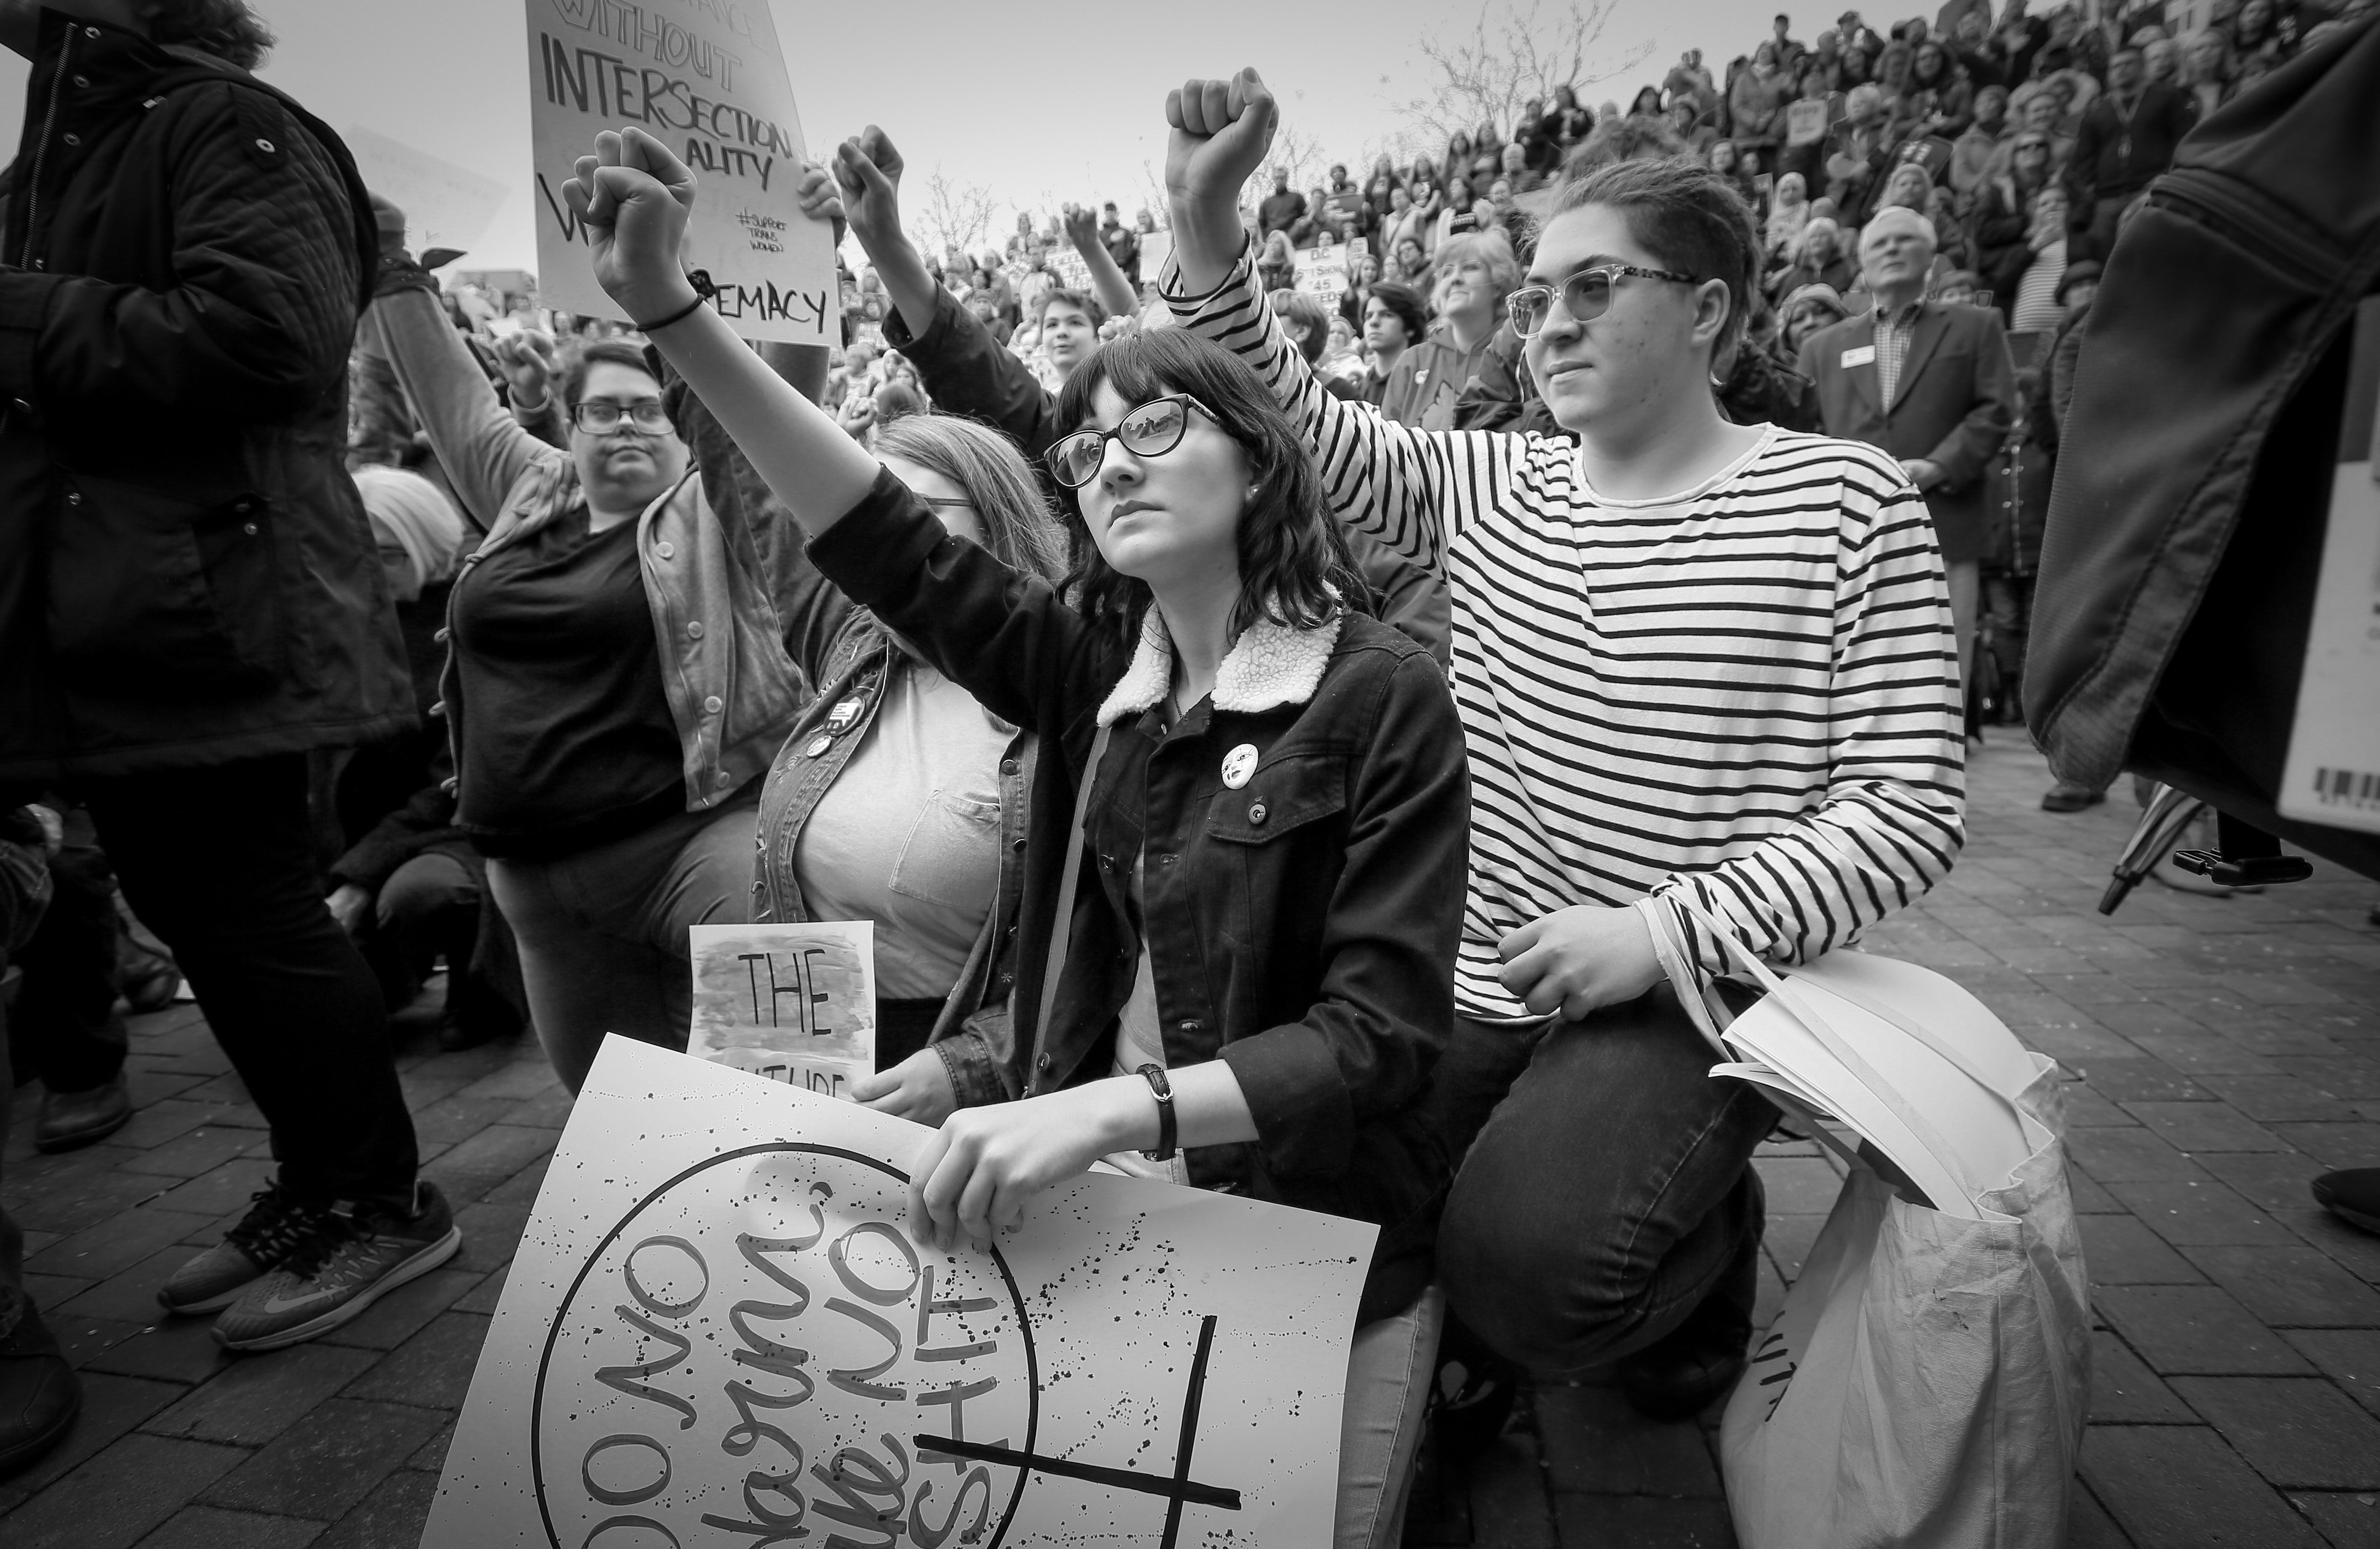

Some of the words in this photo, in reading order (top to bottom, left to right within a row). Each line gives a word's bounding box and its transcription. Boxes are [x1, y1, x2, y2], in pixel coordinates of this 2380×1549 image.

[540, 31, 793, 158] INTERSECTION
[553, 0, 742, 91] WITHOUT
[687, 138, 772, 192] ALITY
[714, 279, 828, 334] EMACY
[738, 949, 832, 1036] THE
[594, 1235, 710, 1430] NO
[824, 1222, 921, 1401] NO
[908, 1264, 1009, 1549] SHIT
